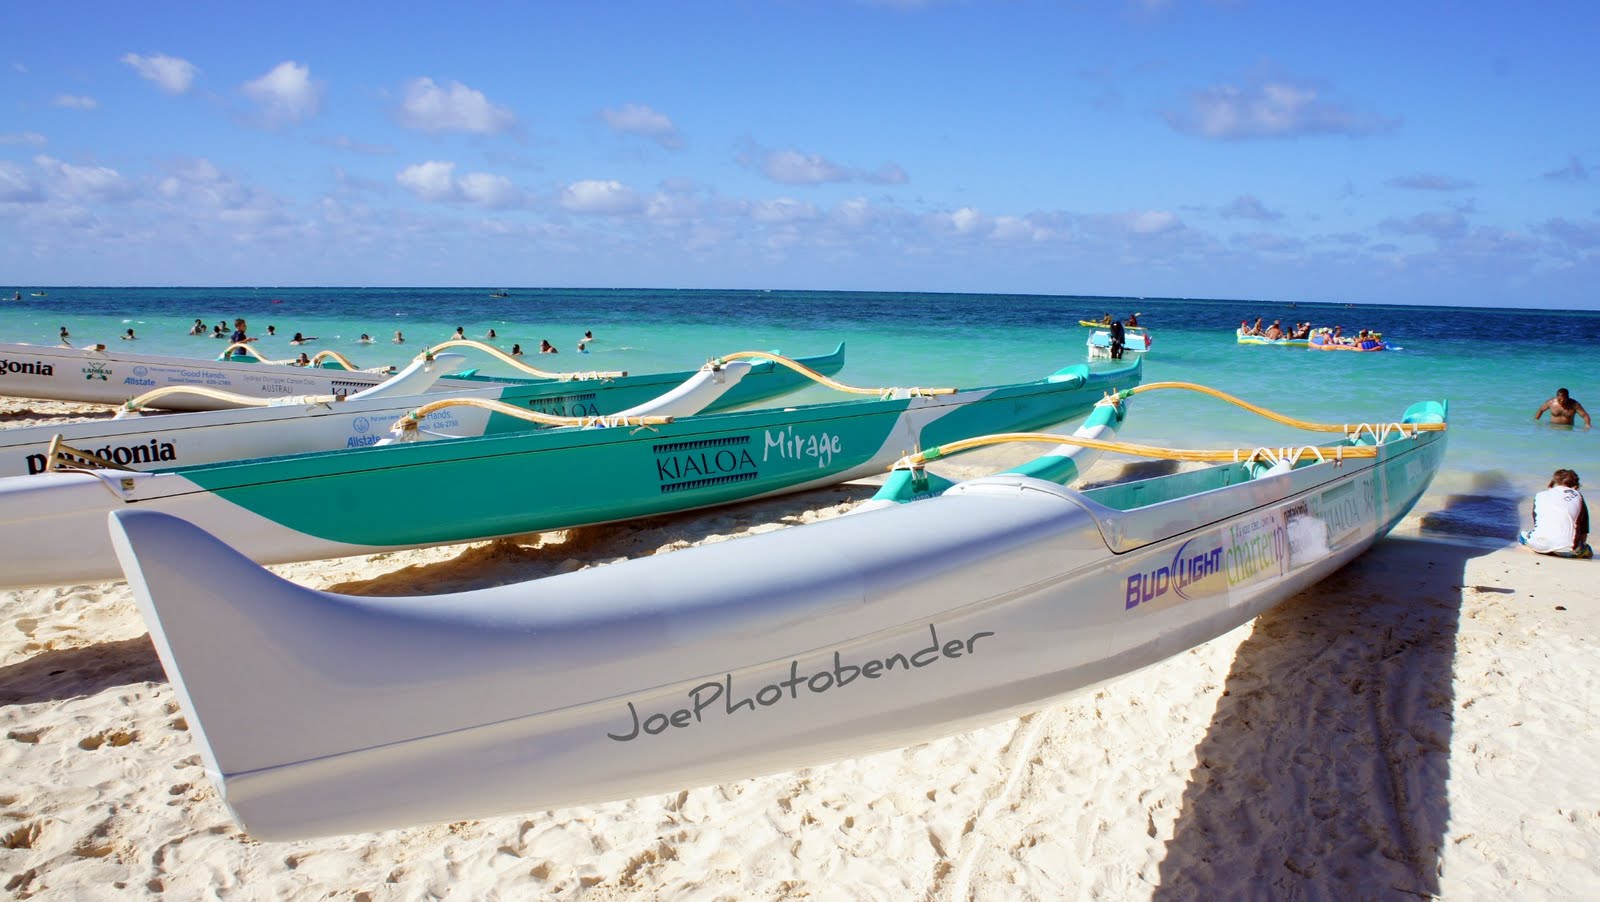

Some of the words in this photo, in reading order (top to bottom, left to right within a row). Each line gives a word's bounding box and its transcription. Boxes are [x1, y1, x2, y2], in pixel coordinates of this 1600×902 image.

[123, 377, 156, 386] Allstate
[180, 369, 200, 377] Good
[347, 435, 381, 448] Allstate
[763, 426, 841, 468] Mirage
[656, 449, 757, 481] KIALOA
[1125, 566, 1169, 611] BUD
[1178, 546, 1223, 589] LIGHT
